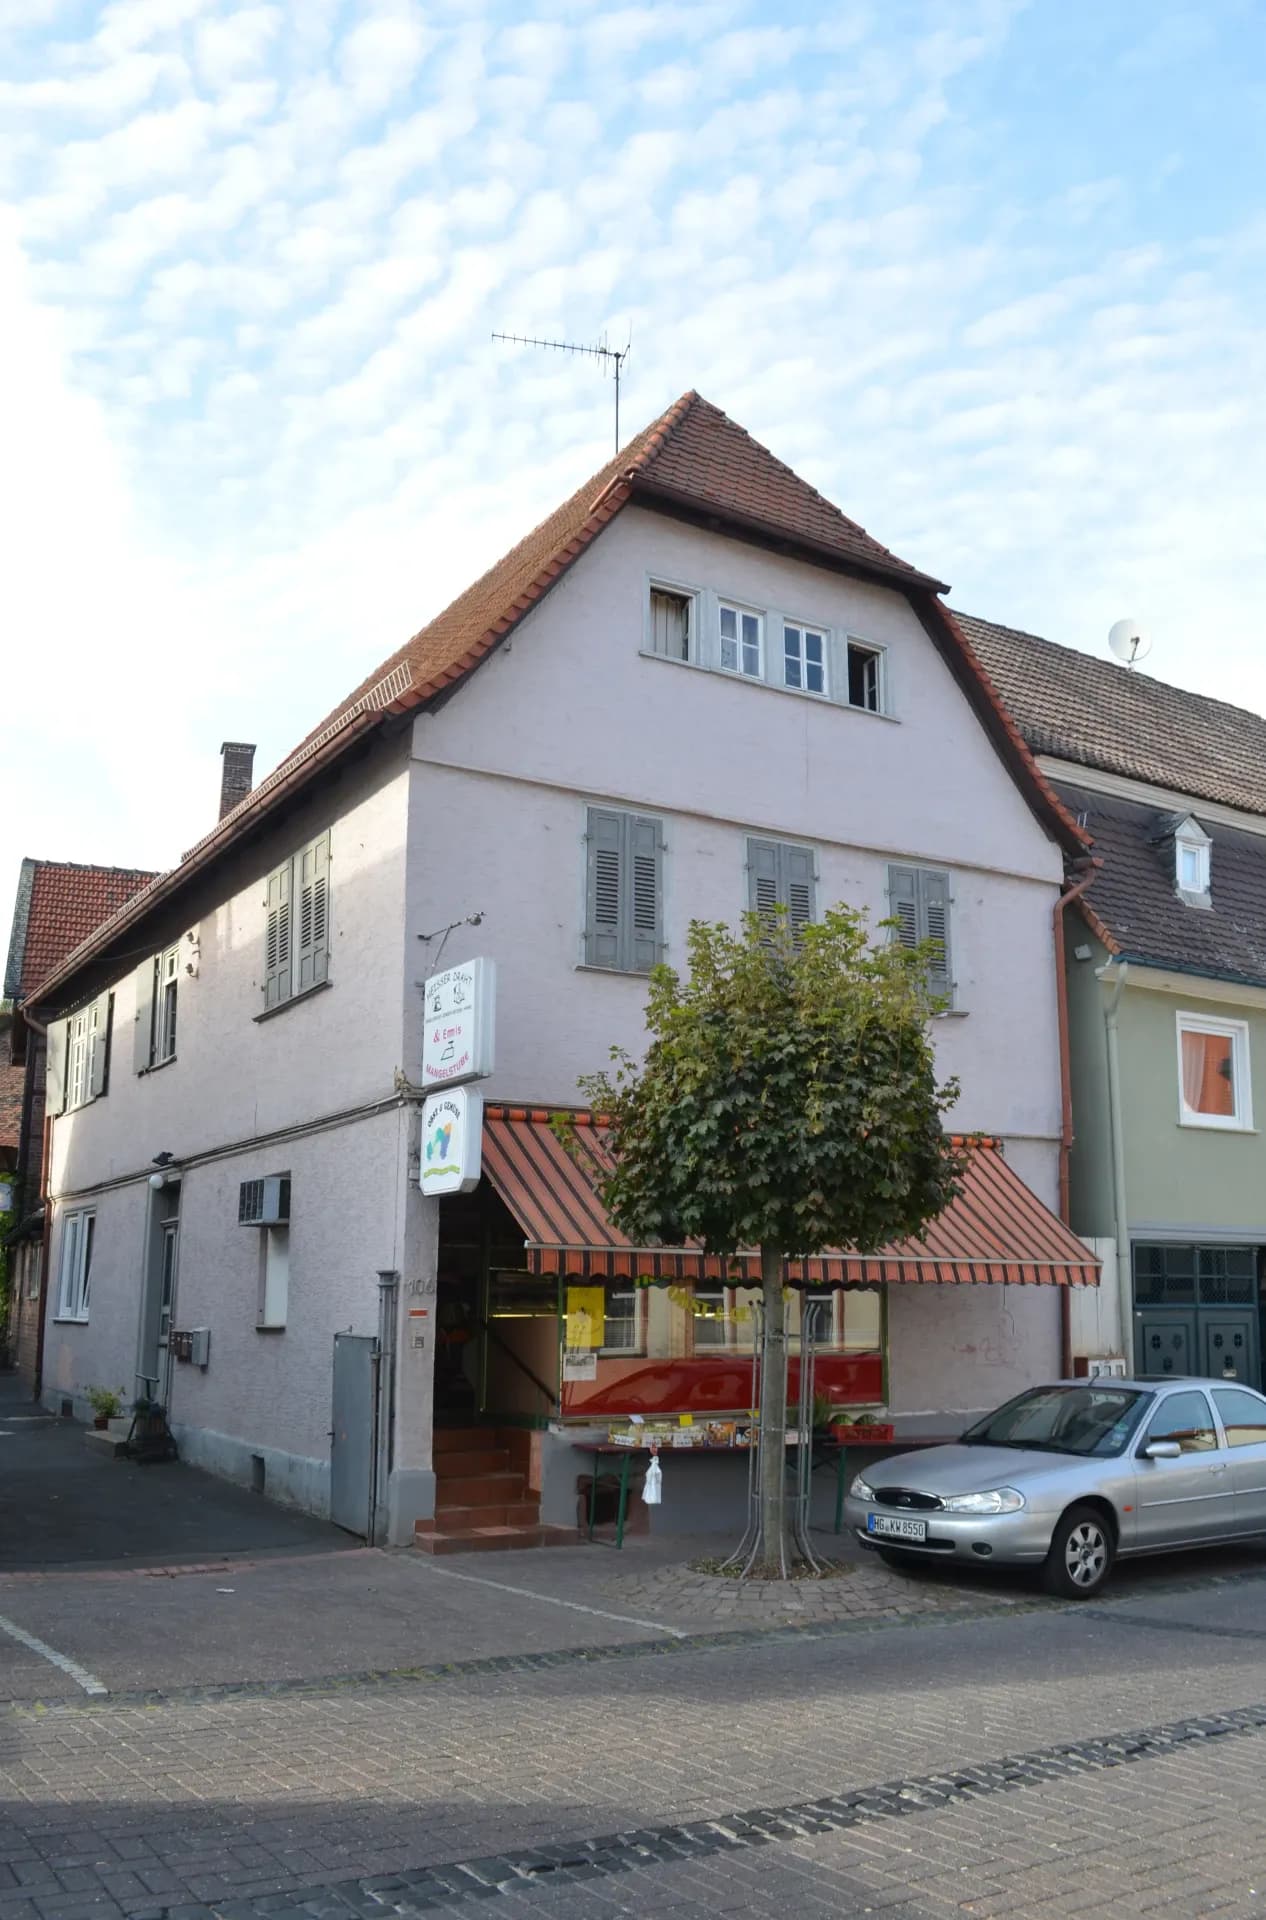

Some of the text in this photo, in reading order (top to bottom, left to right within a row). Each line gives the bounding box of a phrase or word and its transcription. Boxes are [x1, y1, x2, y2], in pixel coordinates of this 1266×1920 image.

[874, 1517, 924, 1537] HG KW 8550
